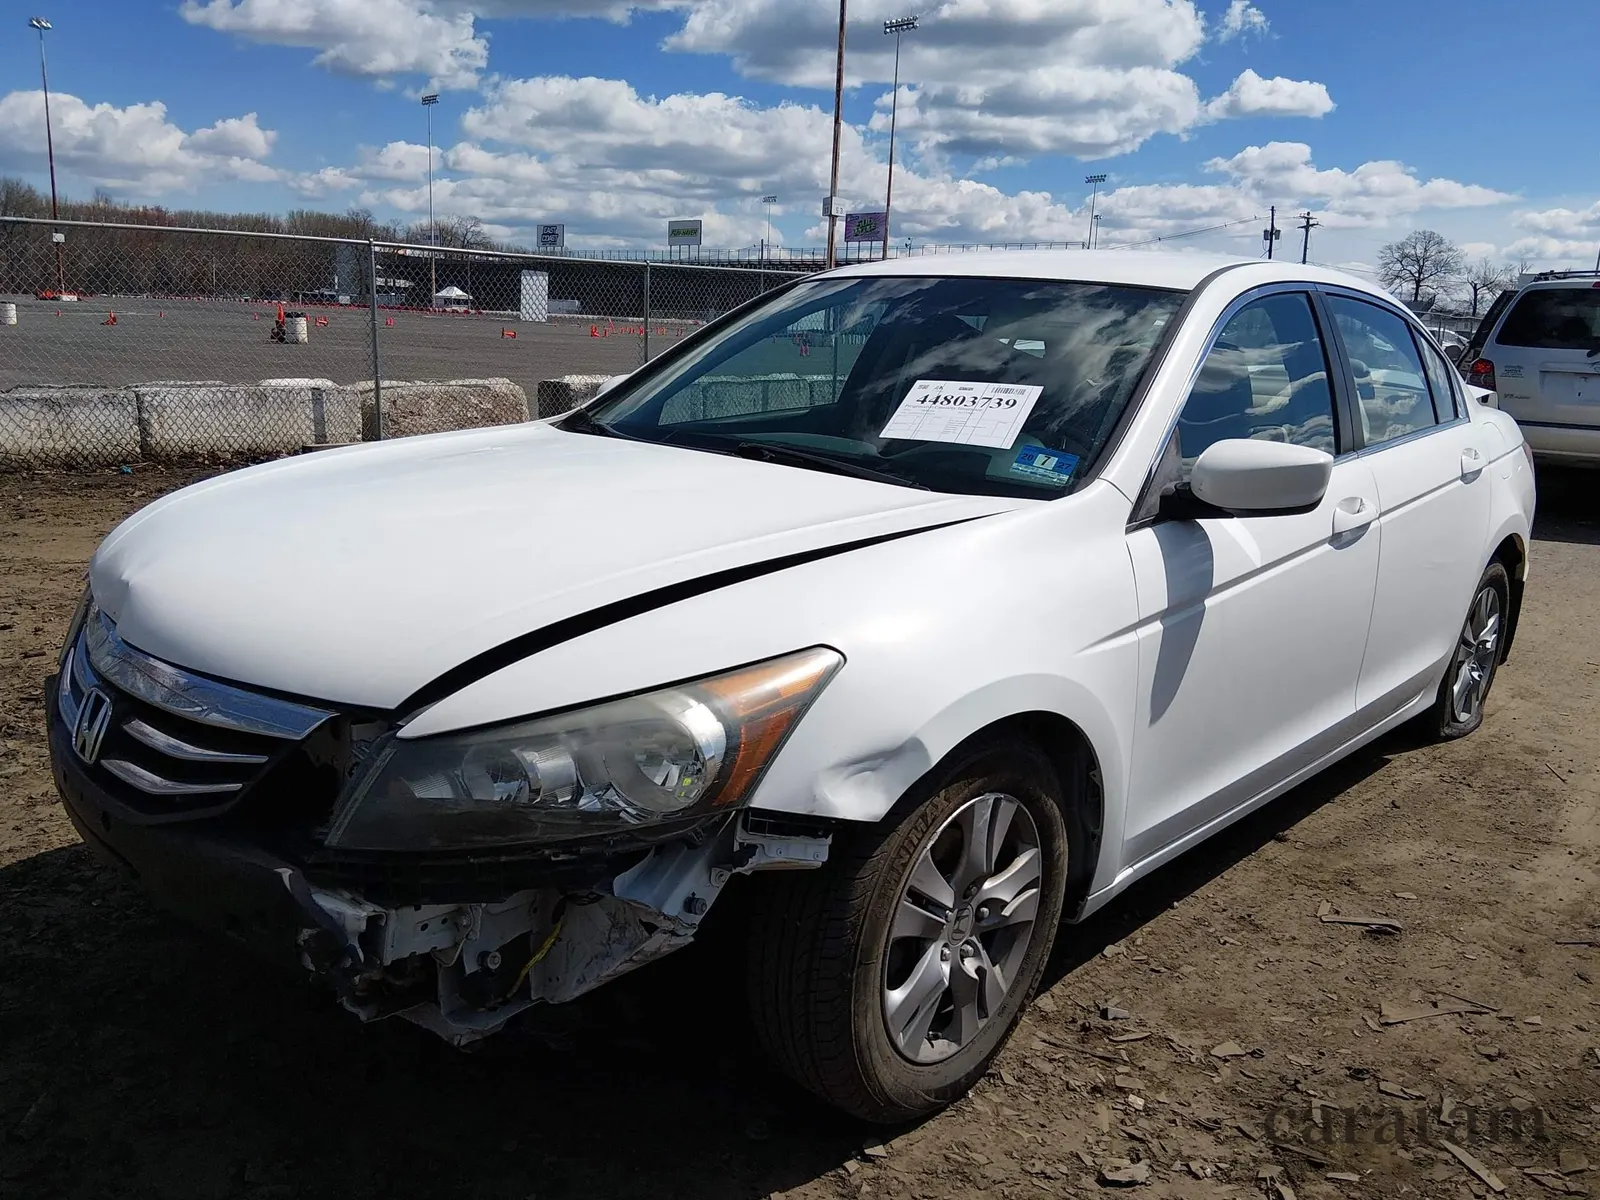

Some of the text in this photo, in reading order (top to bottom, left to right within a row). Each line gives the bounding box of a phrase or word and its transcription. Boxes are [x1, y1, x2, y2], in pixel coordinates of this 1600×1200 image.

[543, 226, 557, 234] EAST
[916, 394, 1017, 410] 44803739
[1041, 455, 1051, 466] 7
